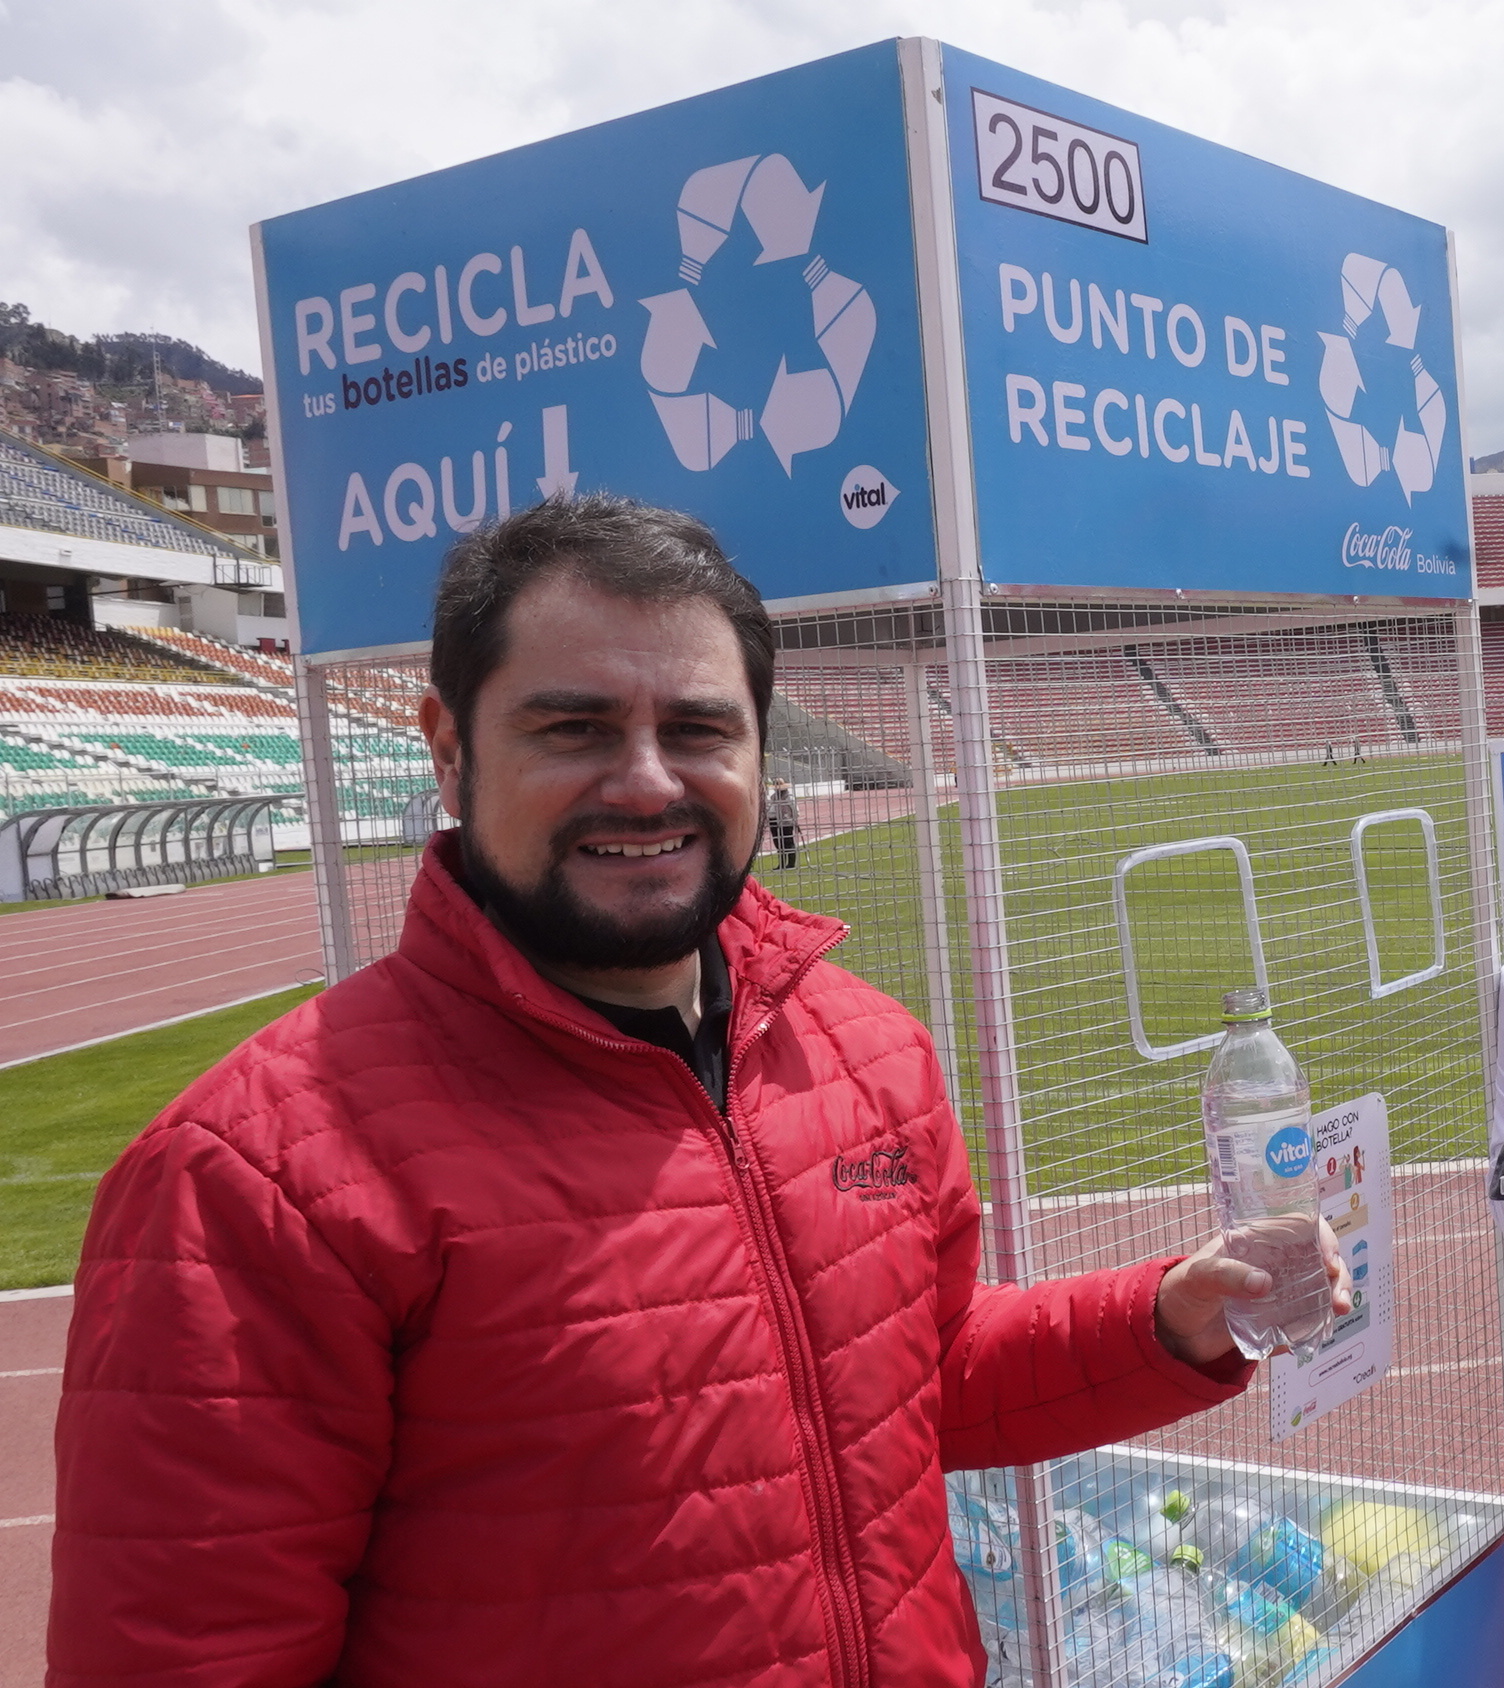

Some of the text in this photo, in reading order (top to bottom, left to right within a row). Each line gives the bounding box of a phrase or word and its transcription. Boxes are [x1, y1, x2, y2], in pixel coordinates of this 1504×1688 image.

[987, 112, 1136, 226] 2500
[294, 227, 615, 376] RECICLA
[998, 262, 1291, 387] PUNTO DE
[302, 332, 618, 419] tus botellas de plástico
[1005, 372, 1312, 480] RECICLAJE
[338, 420, 515, 552] AQUÍ
[842, 481, 886, 511] vital
[1341, 521, 1457, 575] Coca-Cola Bolivia
[1269, 1137, 1310, 1165] vital
[1315, 1127, 1353, 1153] BOTELLA?
[1316, 1111, 1359, 1138] HAGO CON
